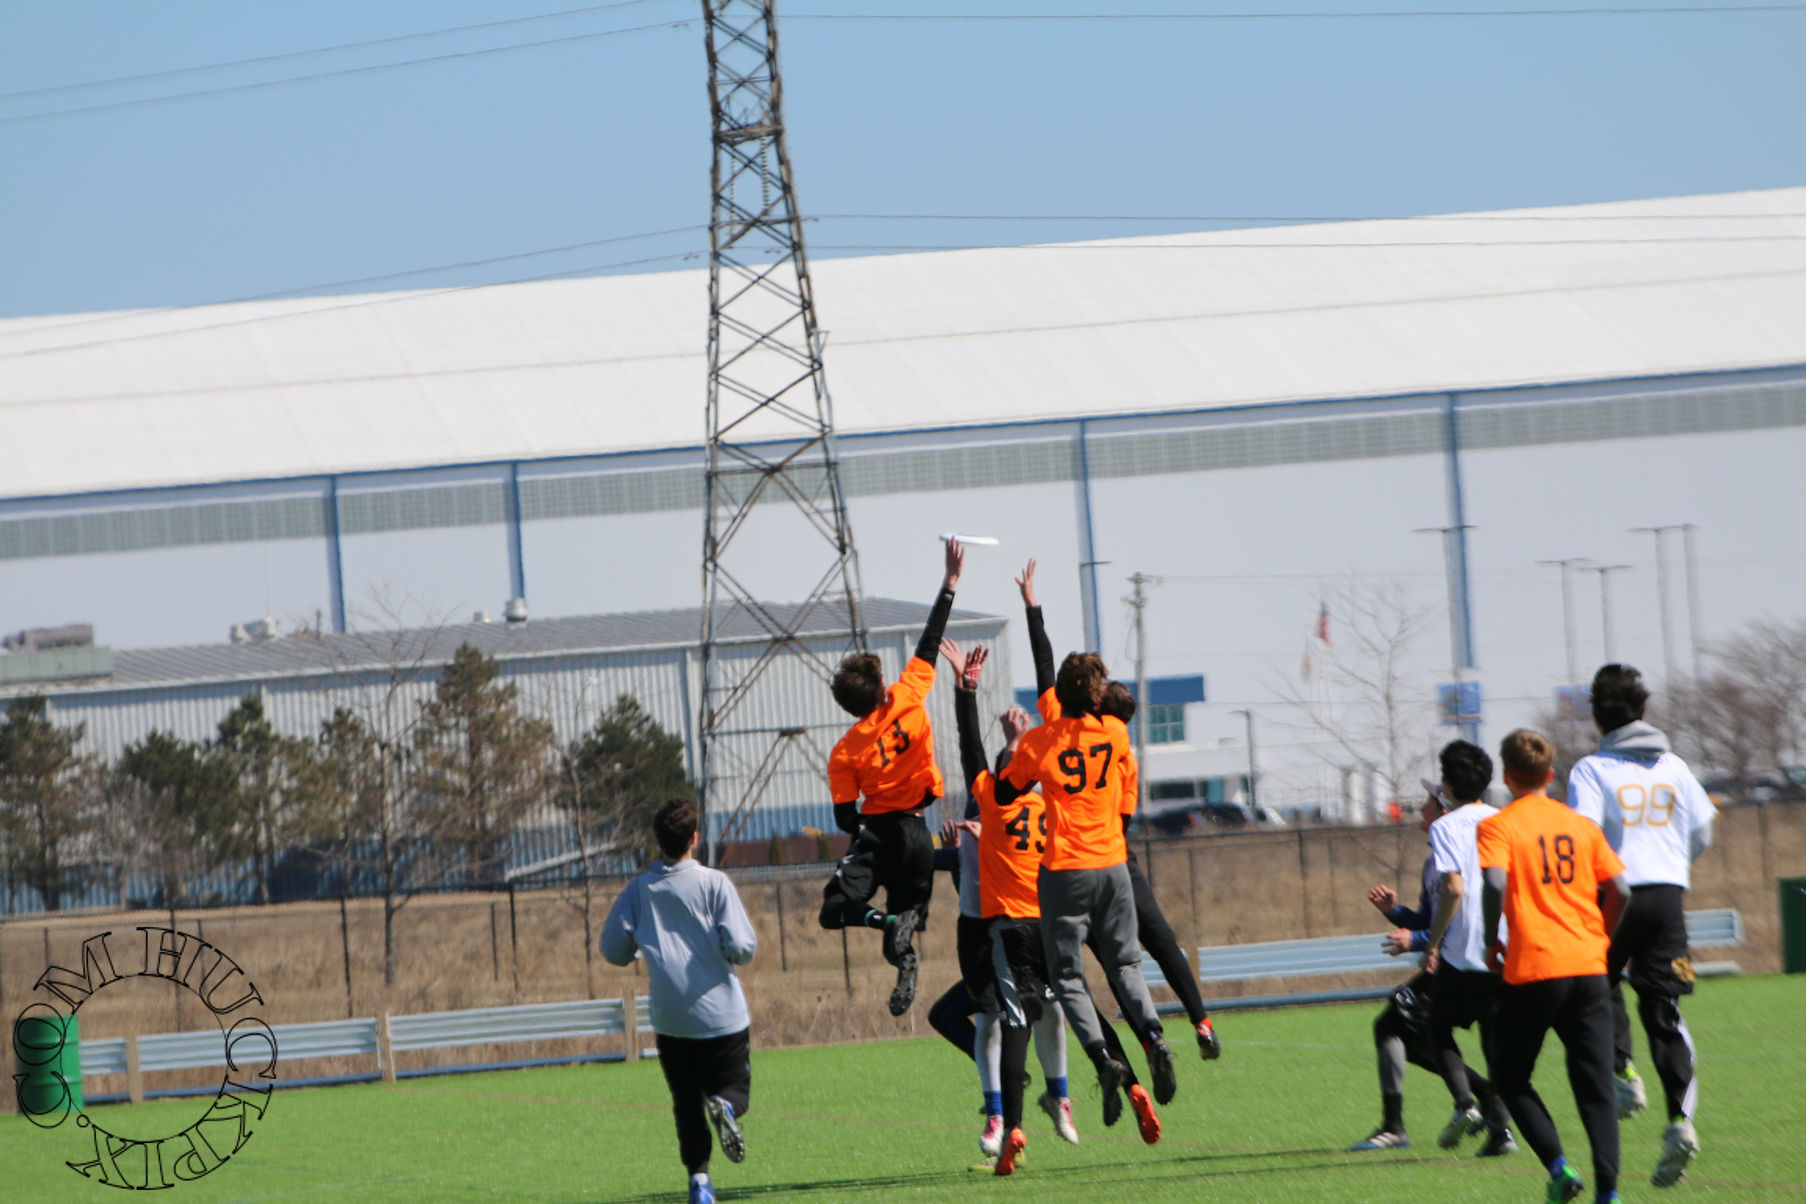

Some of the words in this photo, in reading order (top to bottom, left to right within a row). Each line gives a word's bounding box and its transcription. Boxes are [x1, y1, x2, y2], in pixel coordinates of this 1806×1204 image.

[877, 718, 910, 767] 13
[1058, 742, 1112, 794] 97
[1617, 784, 1676, 827] 99
[1538, 835, 1574, 884] 18
